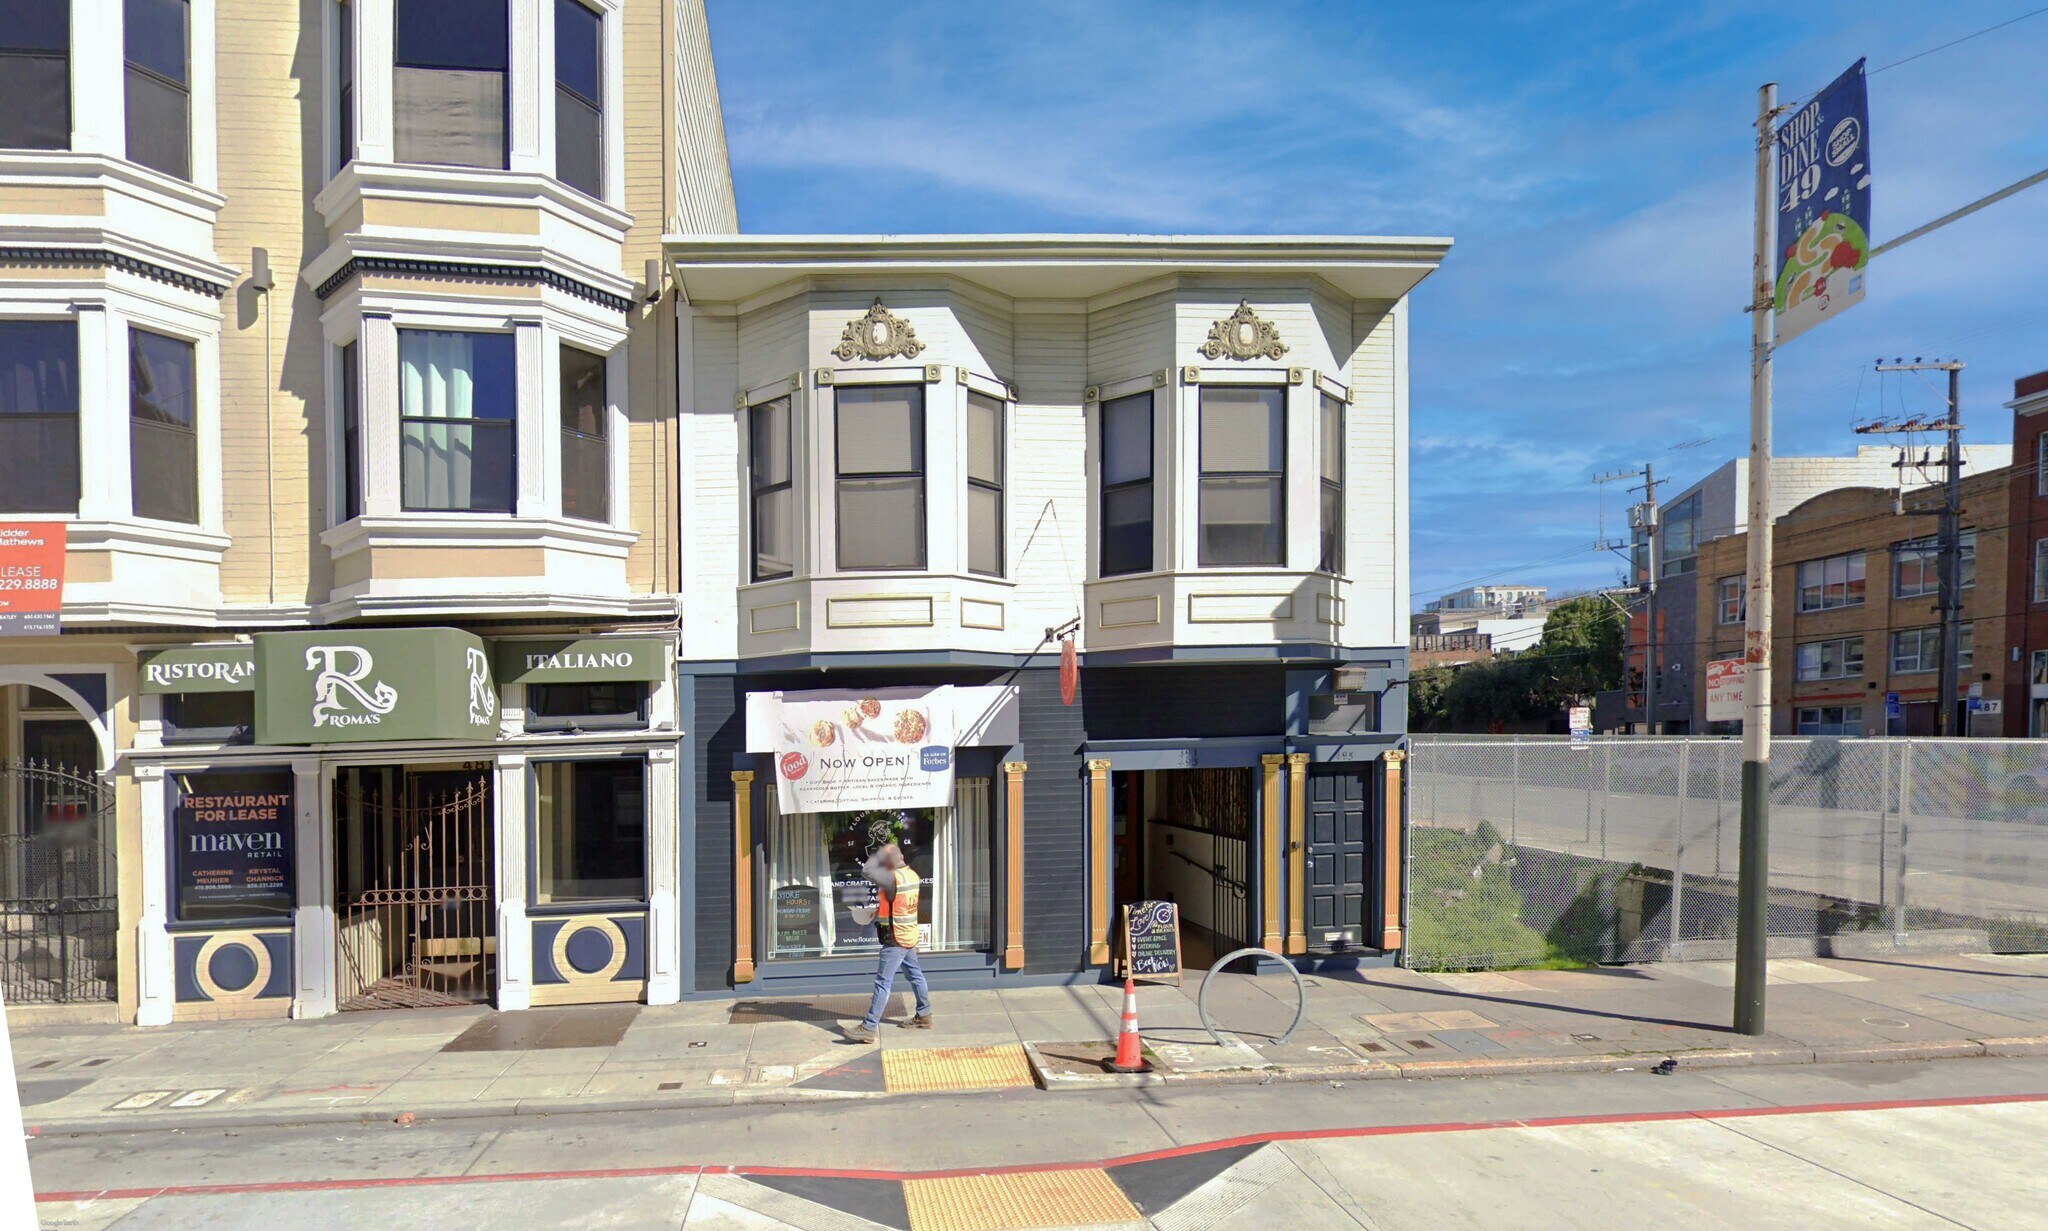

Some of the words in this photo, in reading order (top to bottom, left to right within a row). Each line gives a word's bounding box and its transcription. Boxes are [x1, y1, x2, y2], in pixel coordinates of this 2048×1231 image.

[1781, 102, 1820, 155] SHOP
[1832, 128, 1852, 148] SHOP
[1832, 133, 1855, 158] SMALL
[1781, 129, 1820, 186] DINE
[1779, 164, 1821, 213] 49
[0, 529, 30, 537] idder
[0, 537, 44, 546] athews
[1, 566, 41, 577] LEASE
[526, 652, 633, 670] ITALIANO
[1709, 679, 1720, 687] NO
[1710, 694, 1724, 702] ANY
[1727, 691, 1743, 702] TIME
[329, 714, 381, 728] ROMA'S
[783, 755, 807, 778] food
[820, 758, 857, 769] NOW
[863, 754, 910, 767] OPEN!
[923, 757, 947, 765] Forbes
[184, 795, 289, 809] RESTAURANT
[195, 810, 226, 822] FOR
[229, 808, 277, 821] LEASE
[189, 831, 284, 853] maven
[192, 869, 234, 877] CATHERINE
[248, 867, 281, 875] KRYSTAL
[1130, 909, 1152, 931] Love
